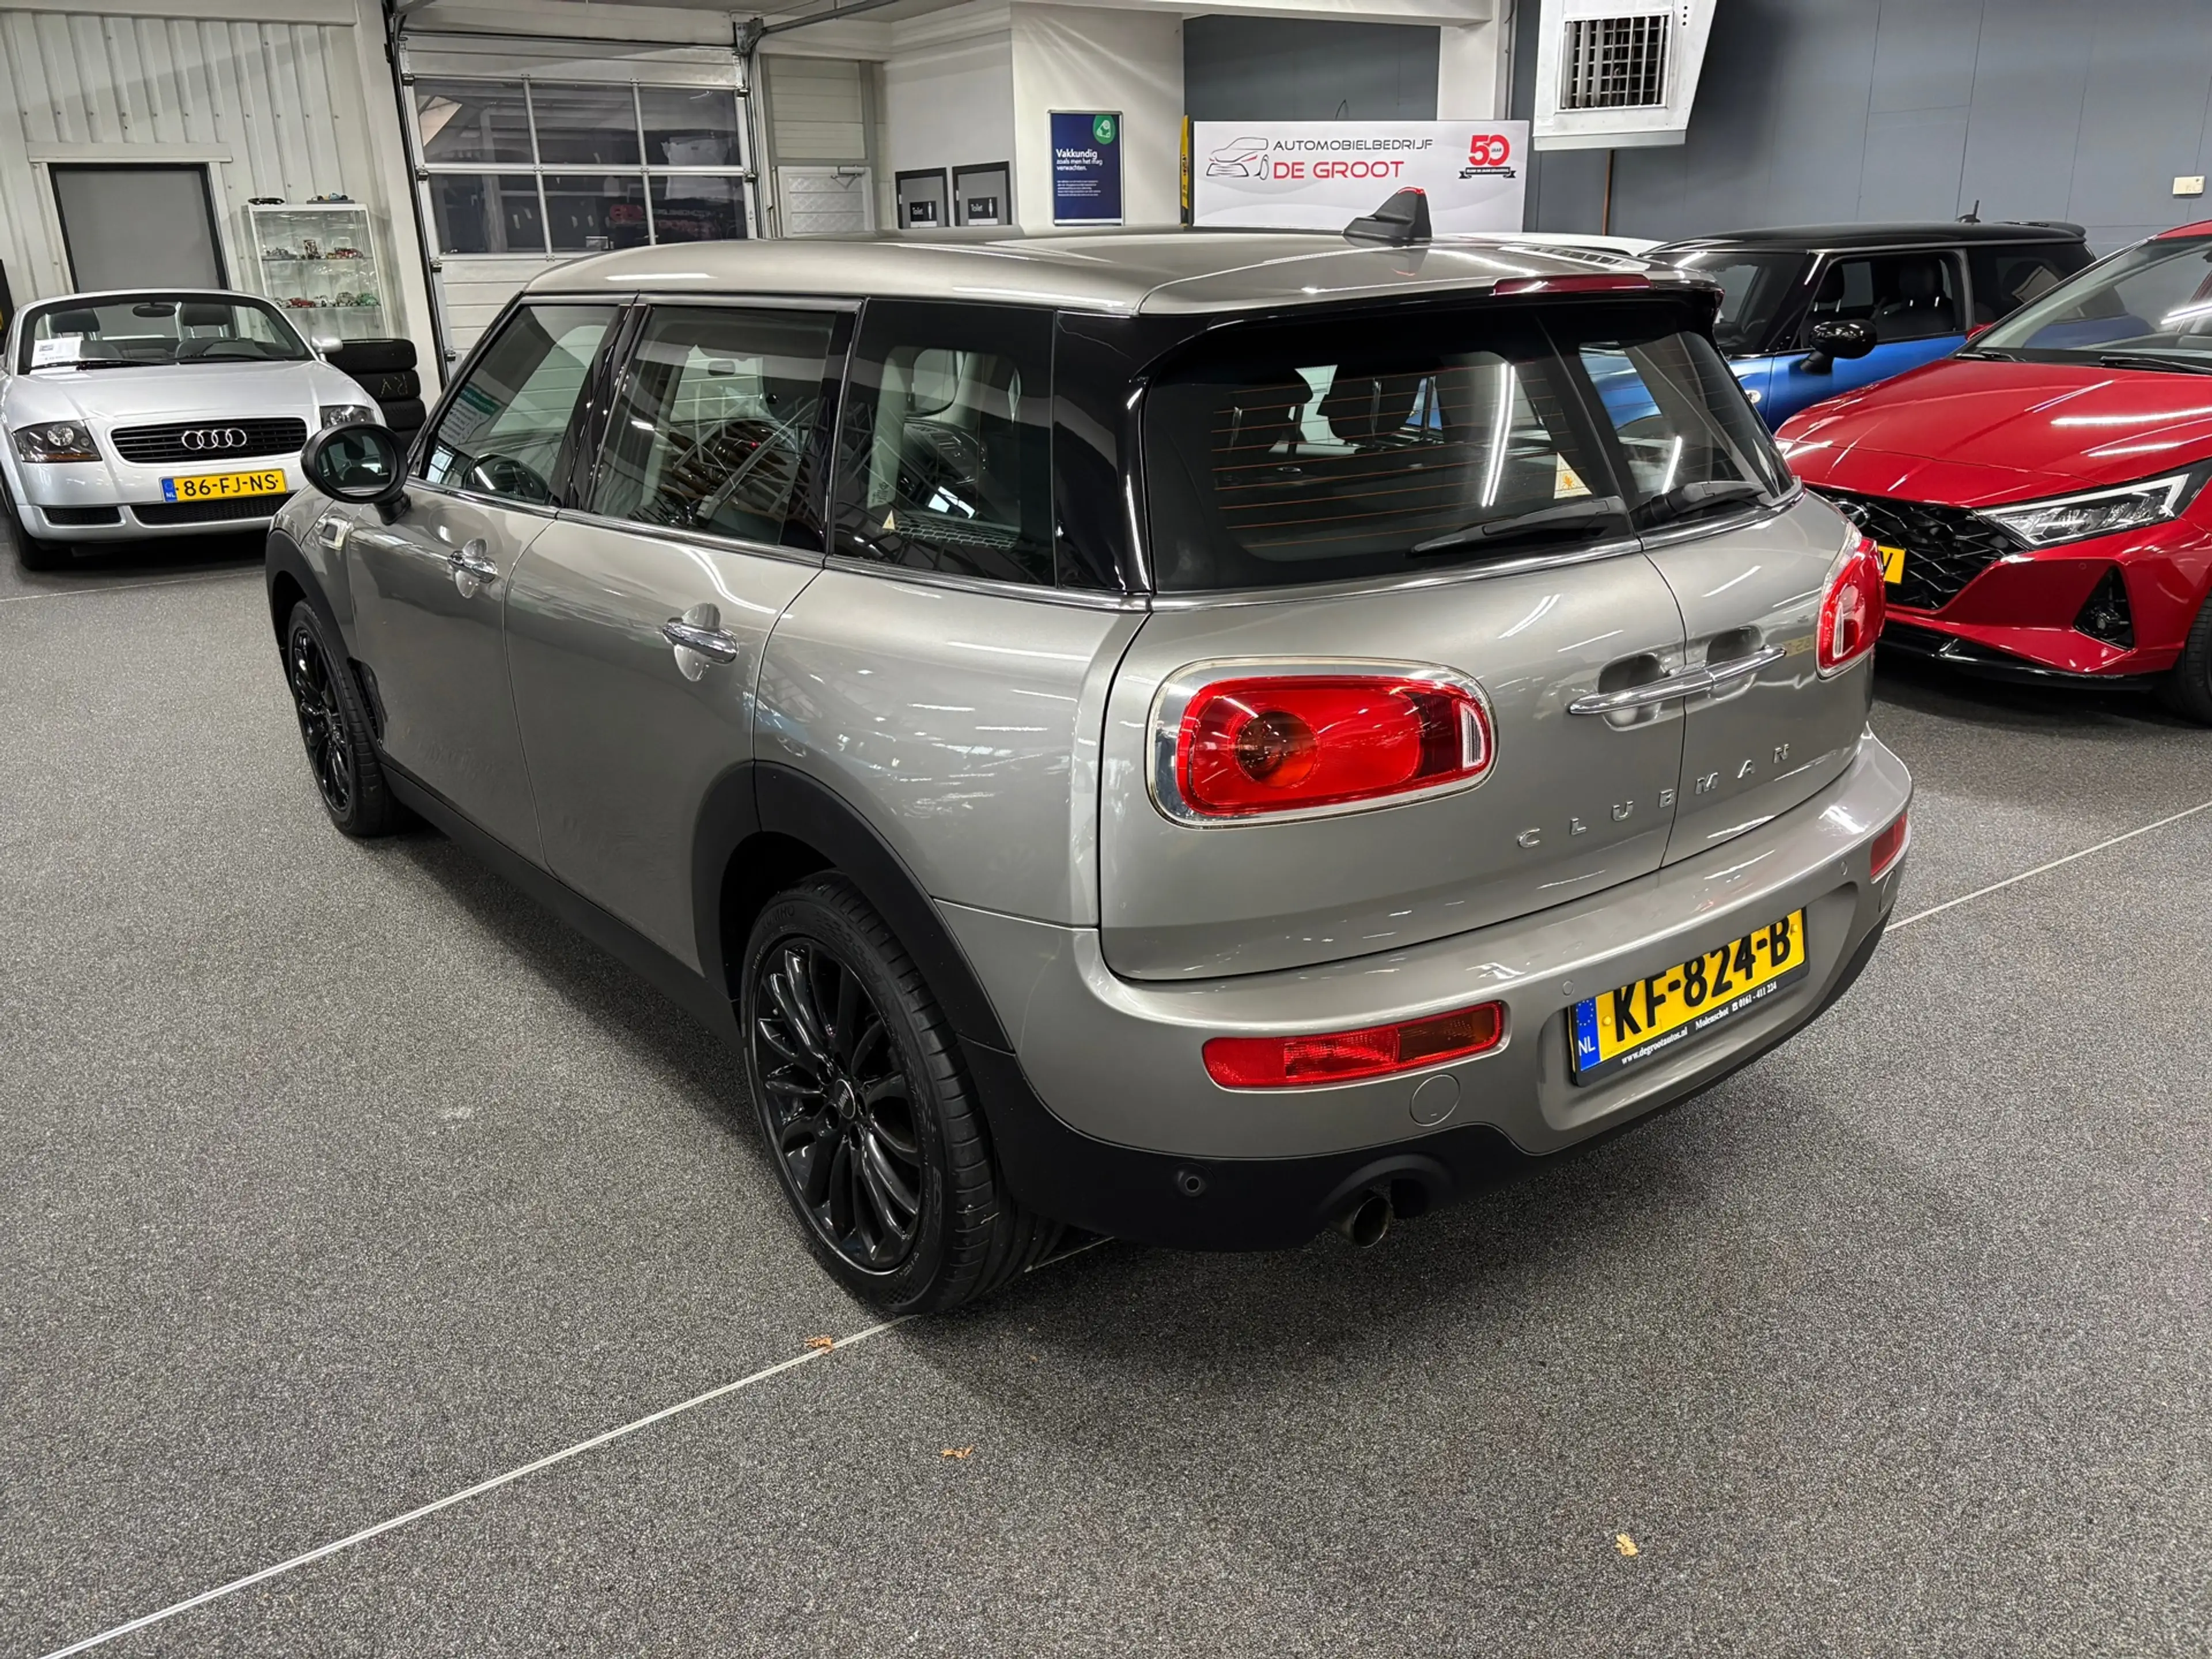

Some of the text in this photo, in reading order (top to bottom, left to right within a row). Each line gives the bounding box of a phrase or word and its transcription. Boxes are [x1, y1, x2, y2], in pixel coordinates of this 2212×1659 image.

[1055, 148, 1098, 160] Vakkundig
[1273, 139, 1433, 151] AUTOMOBIELBEDRIJF
[1468, 135, 1510, 166] 50
[1274, 161, 1405, 179] DE GROOT
[912, 207, 924, 215] Toilet
[969, 203, 983, 213] Toilet
[184, 474, 276, 497] 86-FJ-NS
[1517, 744, 1789, 848] CLUBMAN
[1613, 916, 1791, 1042] KF-824-B
[1622, 1026, 1688, 1065] www.degrootautos.nl
[1695, 1007, 1729, 1031] Molenschot
[1738, 994, 1752, 1008] 0161
[1756, 987, 1766, 998] 411
[1578, 1036, 1596, 1056] NL
